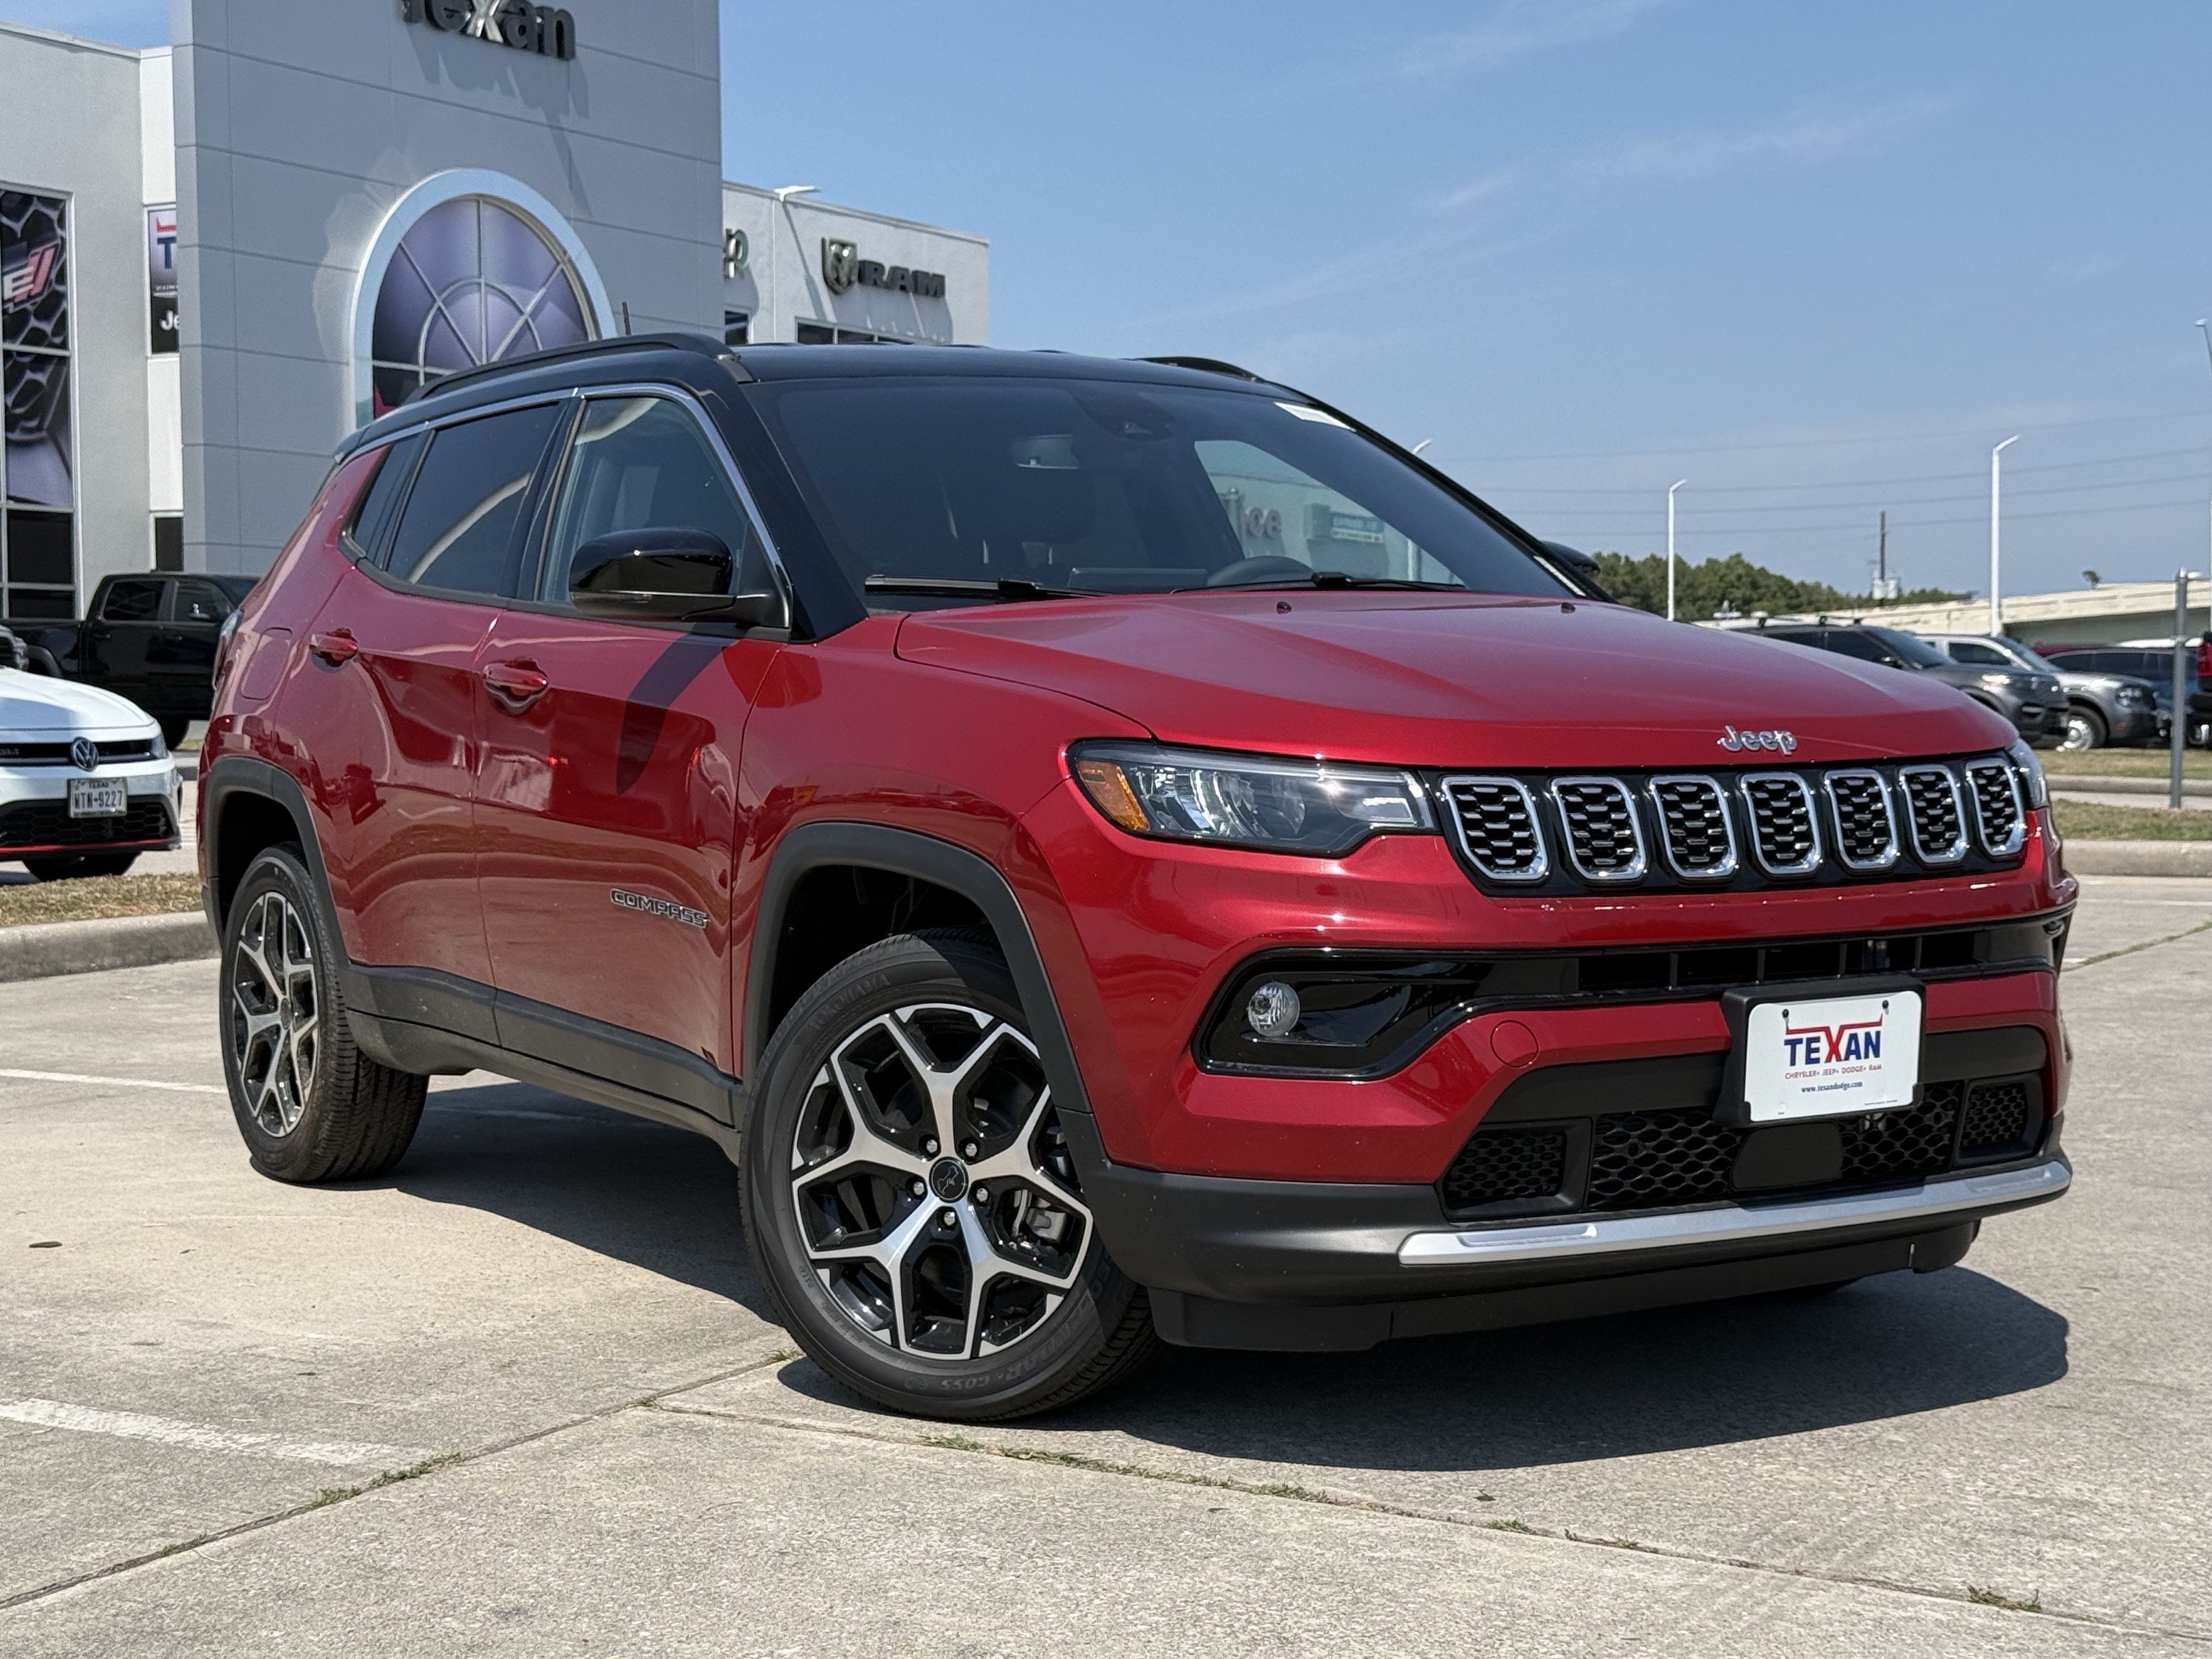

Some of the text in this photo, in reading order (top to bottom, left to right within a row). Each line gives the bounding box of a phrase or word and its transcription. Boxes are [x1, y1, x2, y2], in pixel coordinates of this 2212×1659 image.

[857, 259, 946, 298] RAM
[1717, 725, 1798, 755] Jeep
[610, 888, 708, 929] COMPASS
[1784, 1023, 1881, 1066] TEXAN
